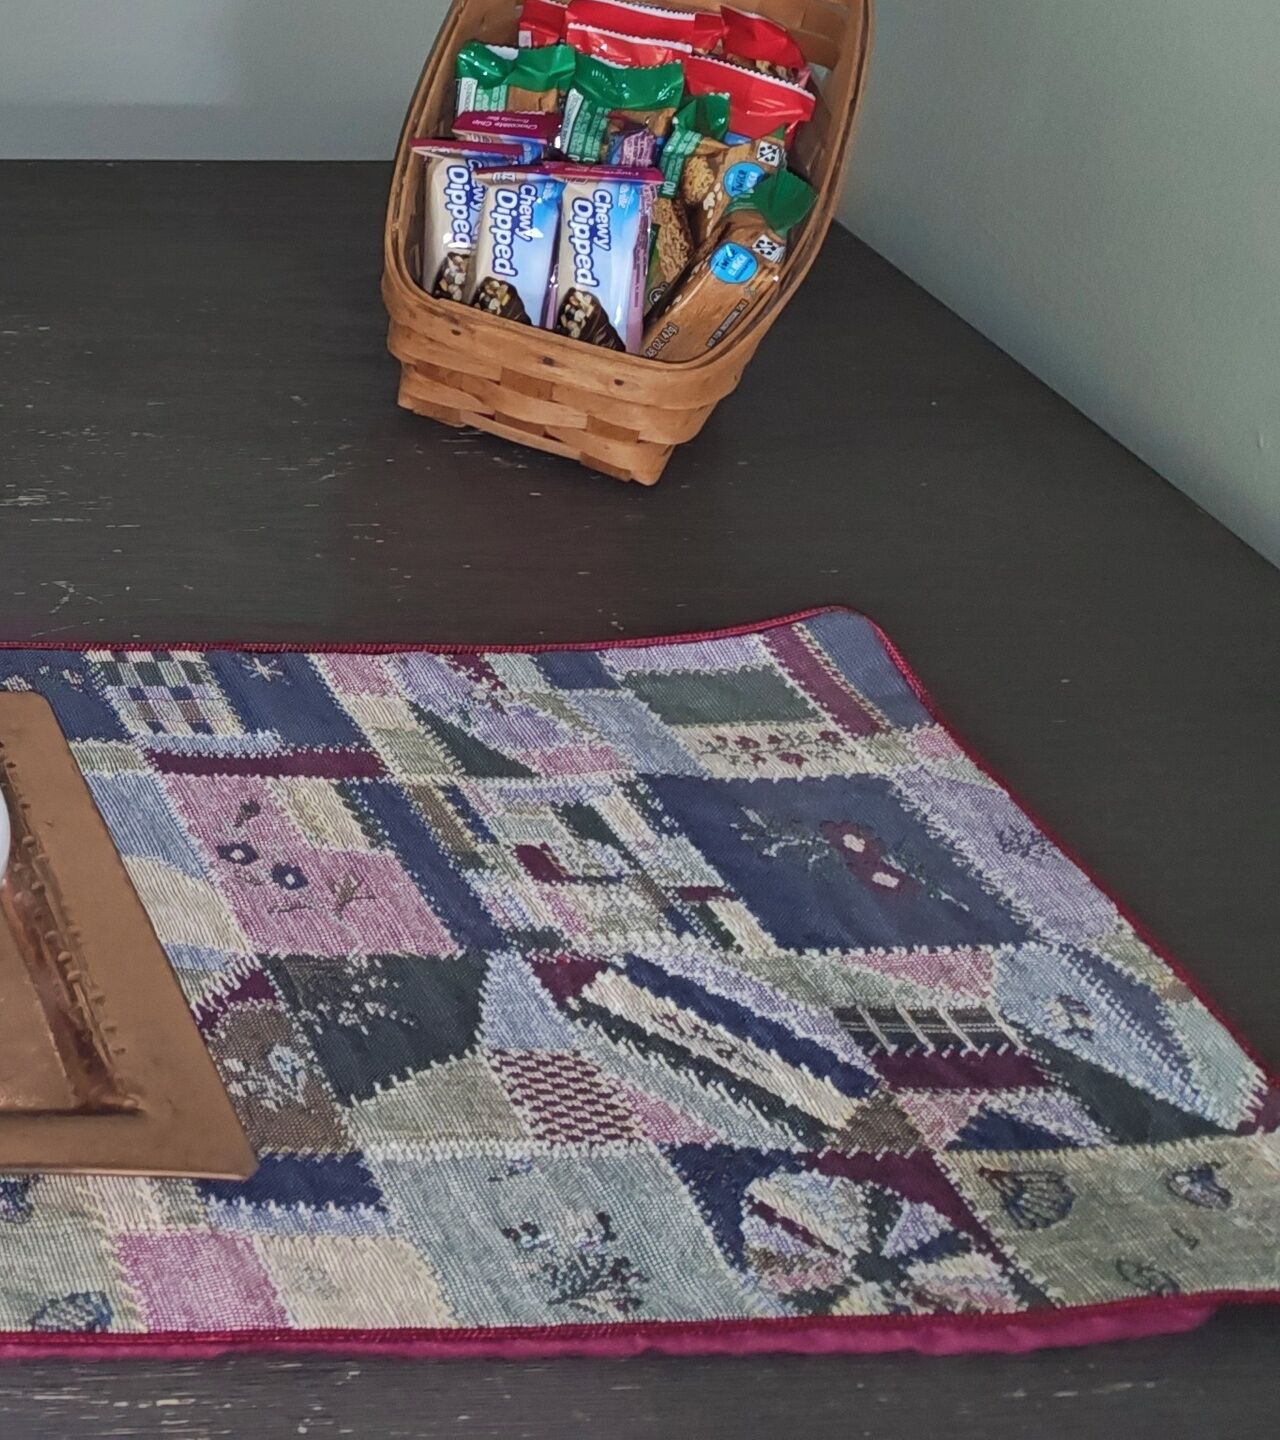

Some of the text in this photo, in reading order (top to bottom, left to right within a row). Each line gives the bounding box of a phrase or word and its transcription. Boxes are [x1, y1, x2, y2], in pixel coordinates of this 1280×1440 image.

[467, 159, 486, 212] Cwy
[514, 183, 538, 242] Chewy
[490, 189, 518, 277] Dipped
[568, 197, 599, 287] Dipped
[593, 189, 613, 251] Chewy
